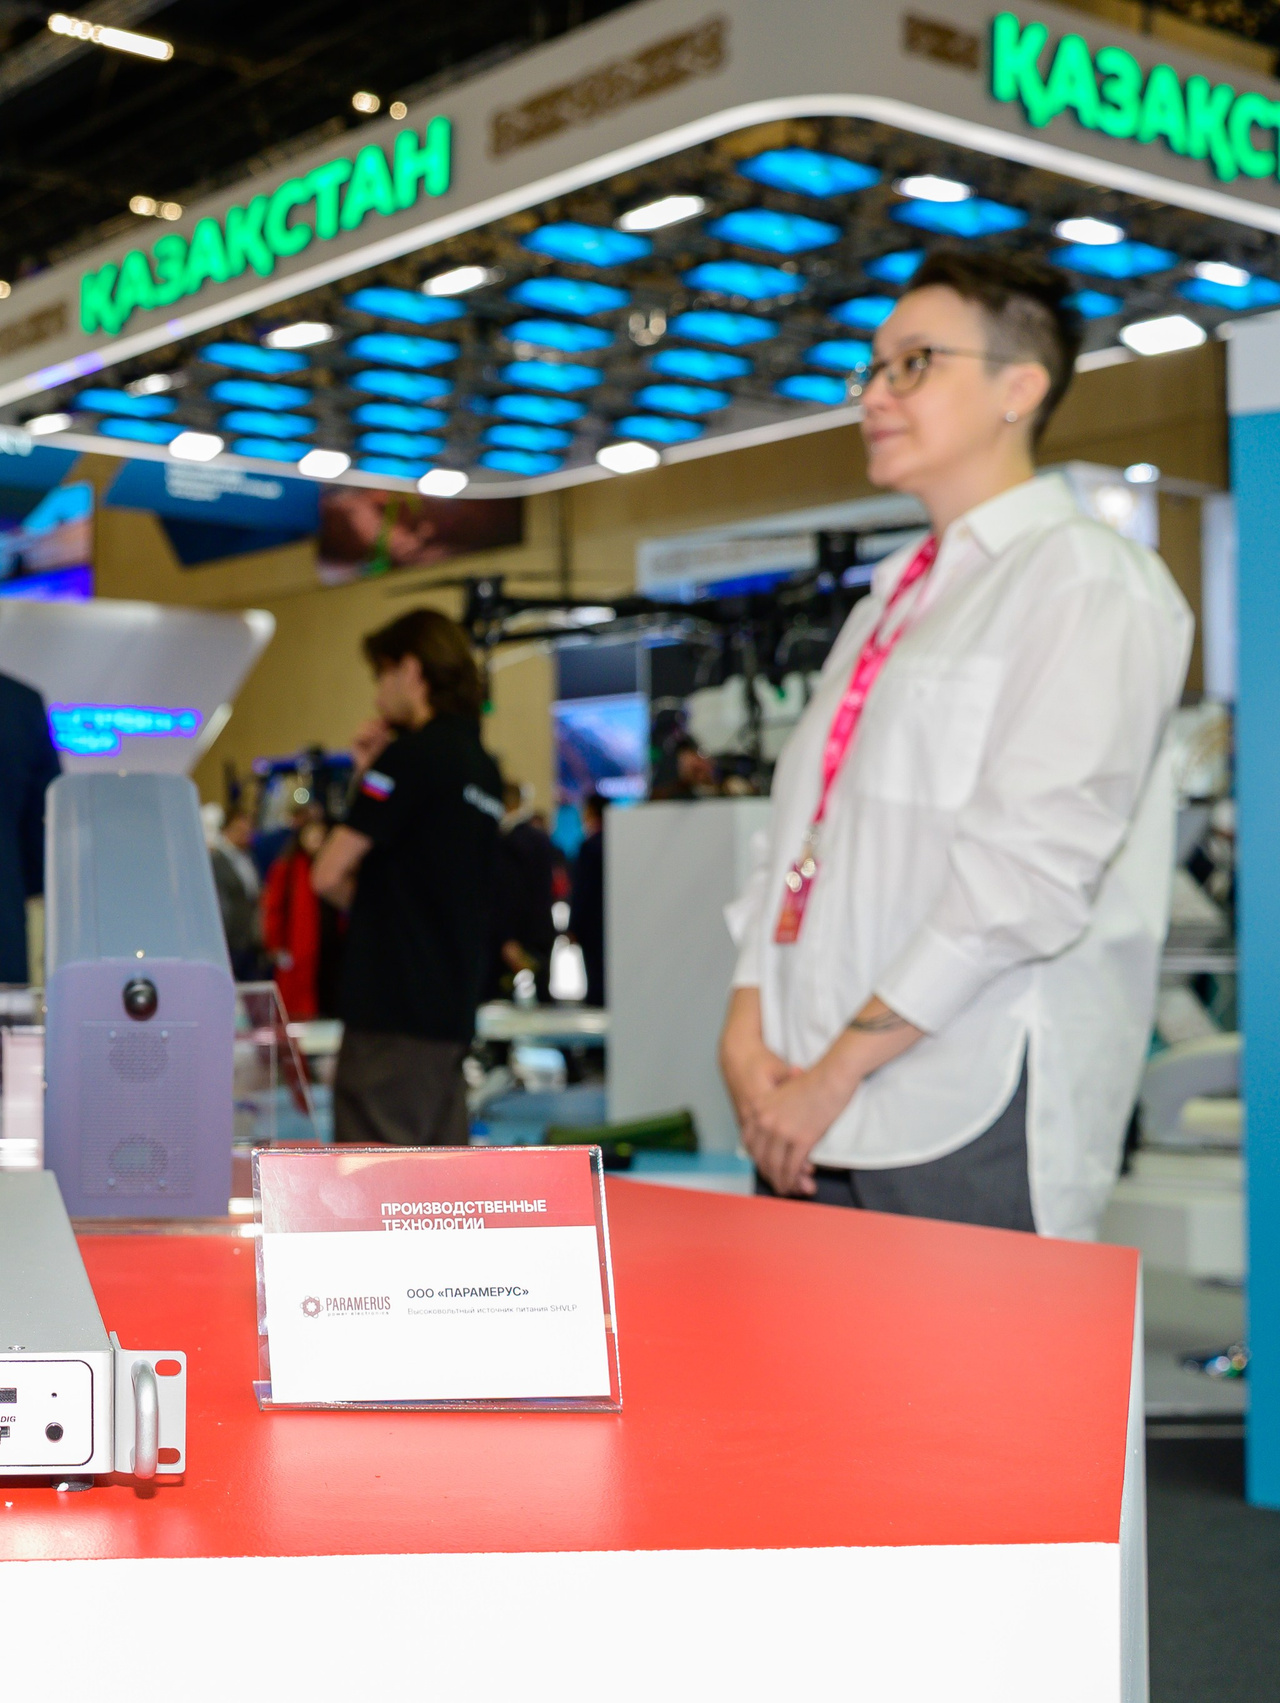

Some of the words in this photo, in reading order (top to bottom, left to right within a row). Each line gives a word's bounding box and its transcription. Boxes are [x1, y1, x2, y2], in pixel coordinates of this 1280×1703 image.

[381, 1199, 547, 1216] ПРОИЗВОДСТВЕННЫЕ
[382, 1217, 485, 1231] ТЕХНОЛОГИИ
[406, 1288, 435, 1299] ООО
[437, 1286, 529, 1298] «ПАРАМЕРУС»
[325, 1296, 391, 1311] PARAMERUS
